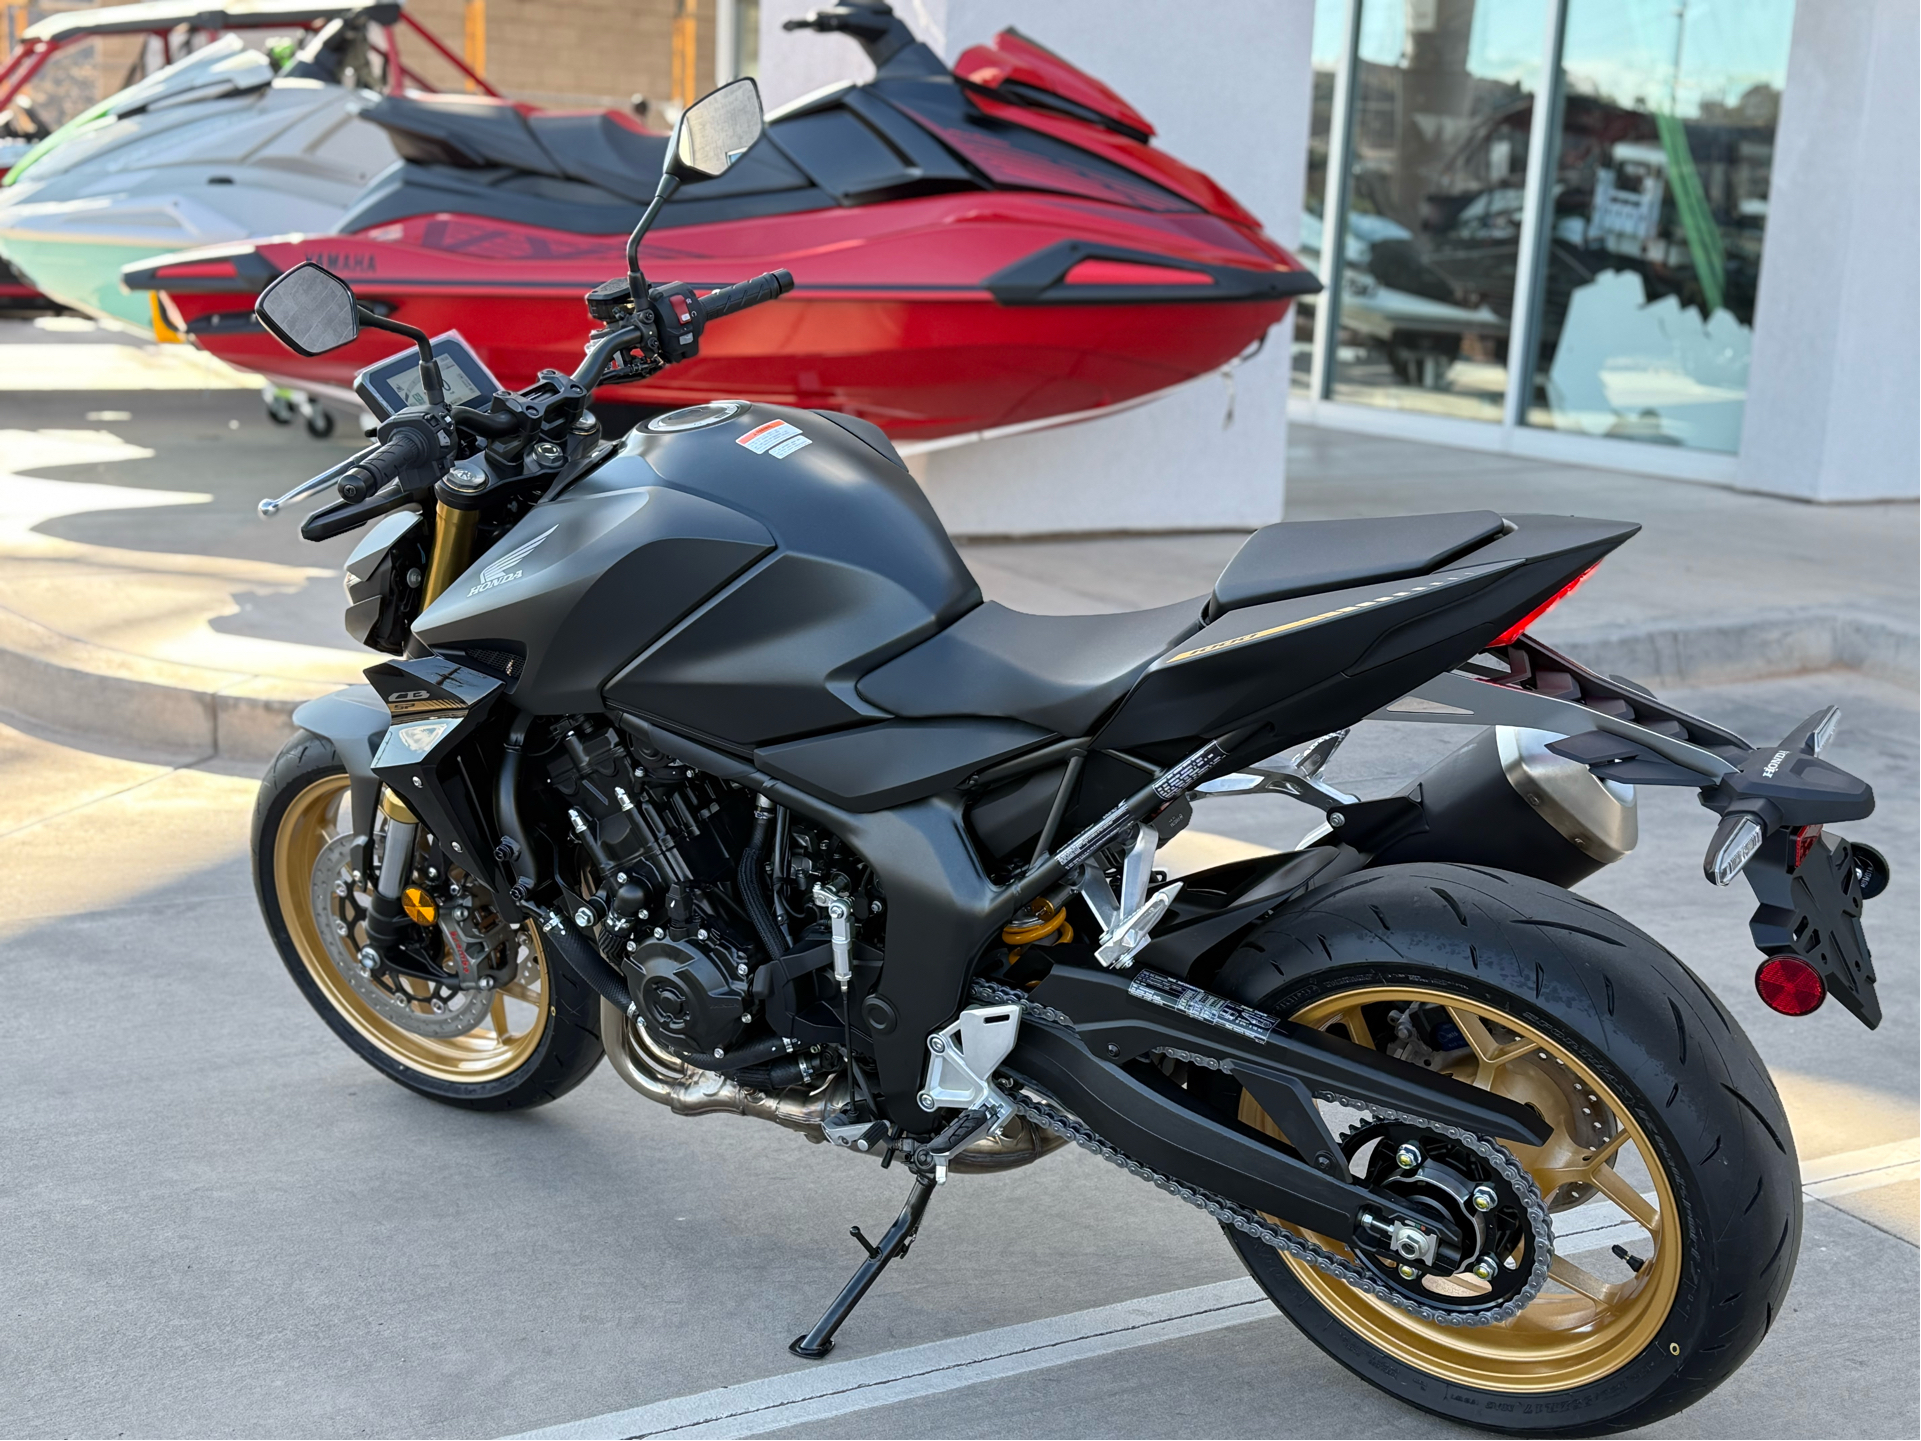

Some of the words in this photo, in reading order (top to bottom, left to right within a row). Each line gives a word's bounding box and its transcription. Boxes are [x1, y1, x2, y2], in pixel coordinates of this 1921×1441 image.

[304, 252, 376, 273] YAMAHA
[466, 569, 523, 598] HONDA
[387, 690, 430, 702] CB
[1762, 750, 1791, 779] HONDA
[450, 931, 470, 974] brembo
